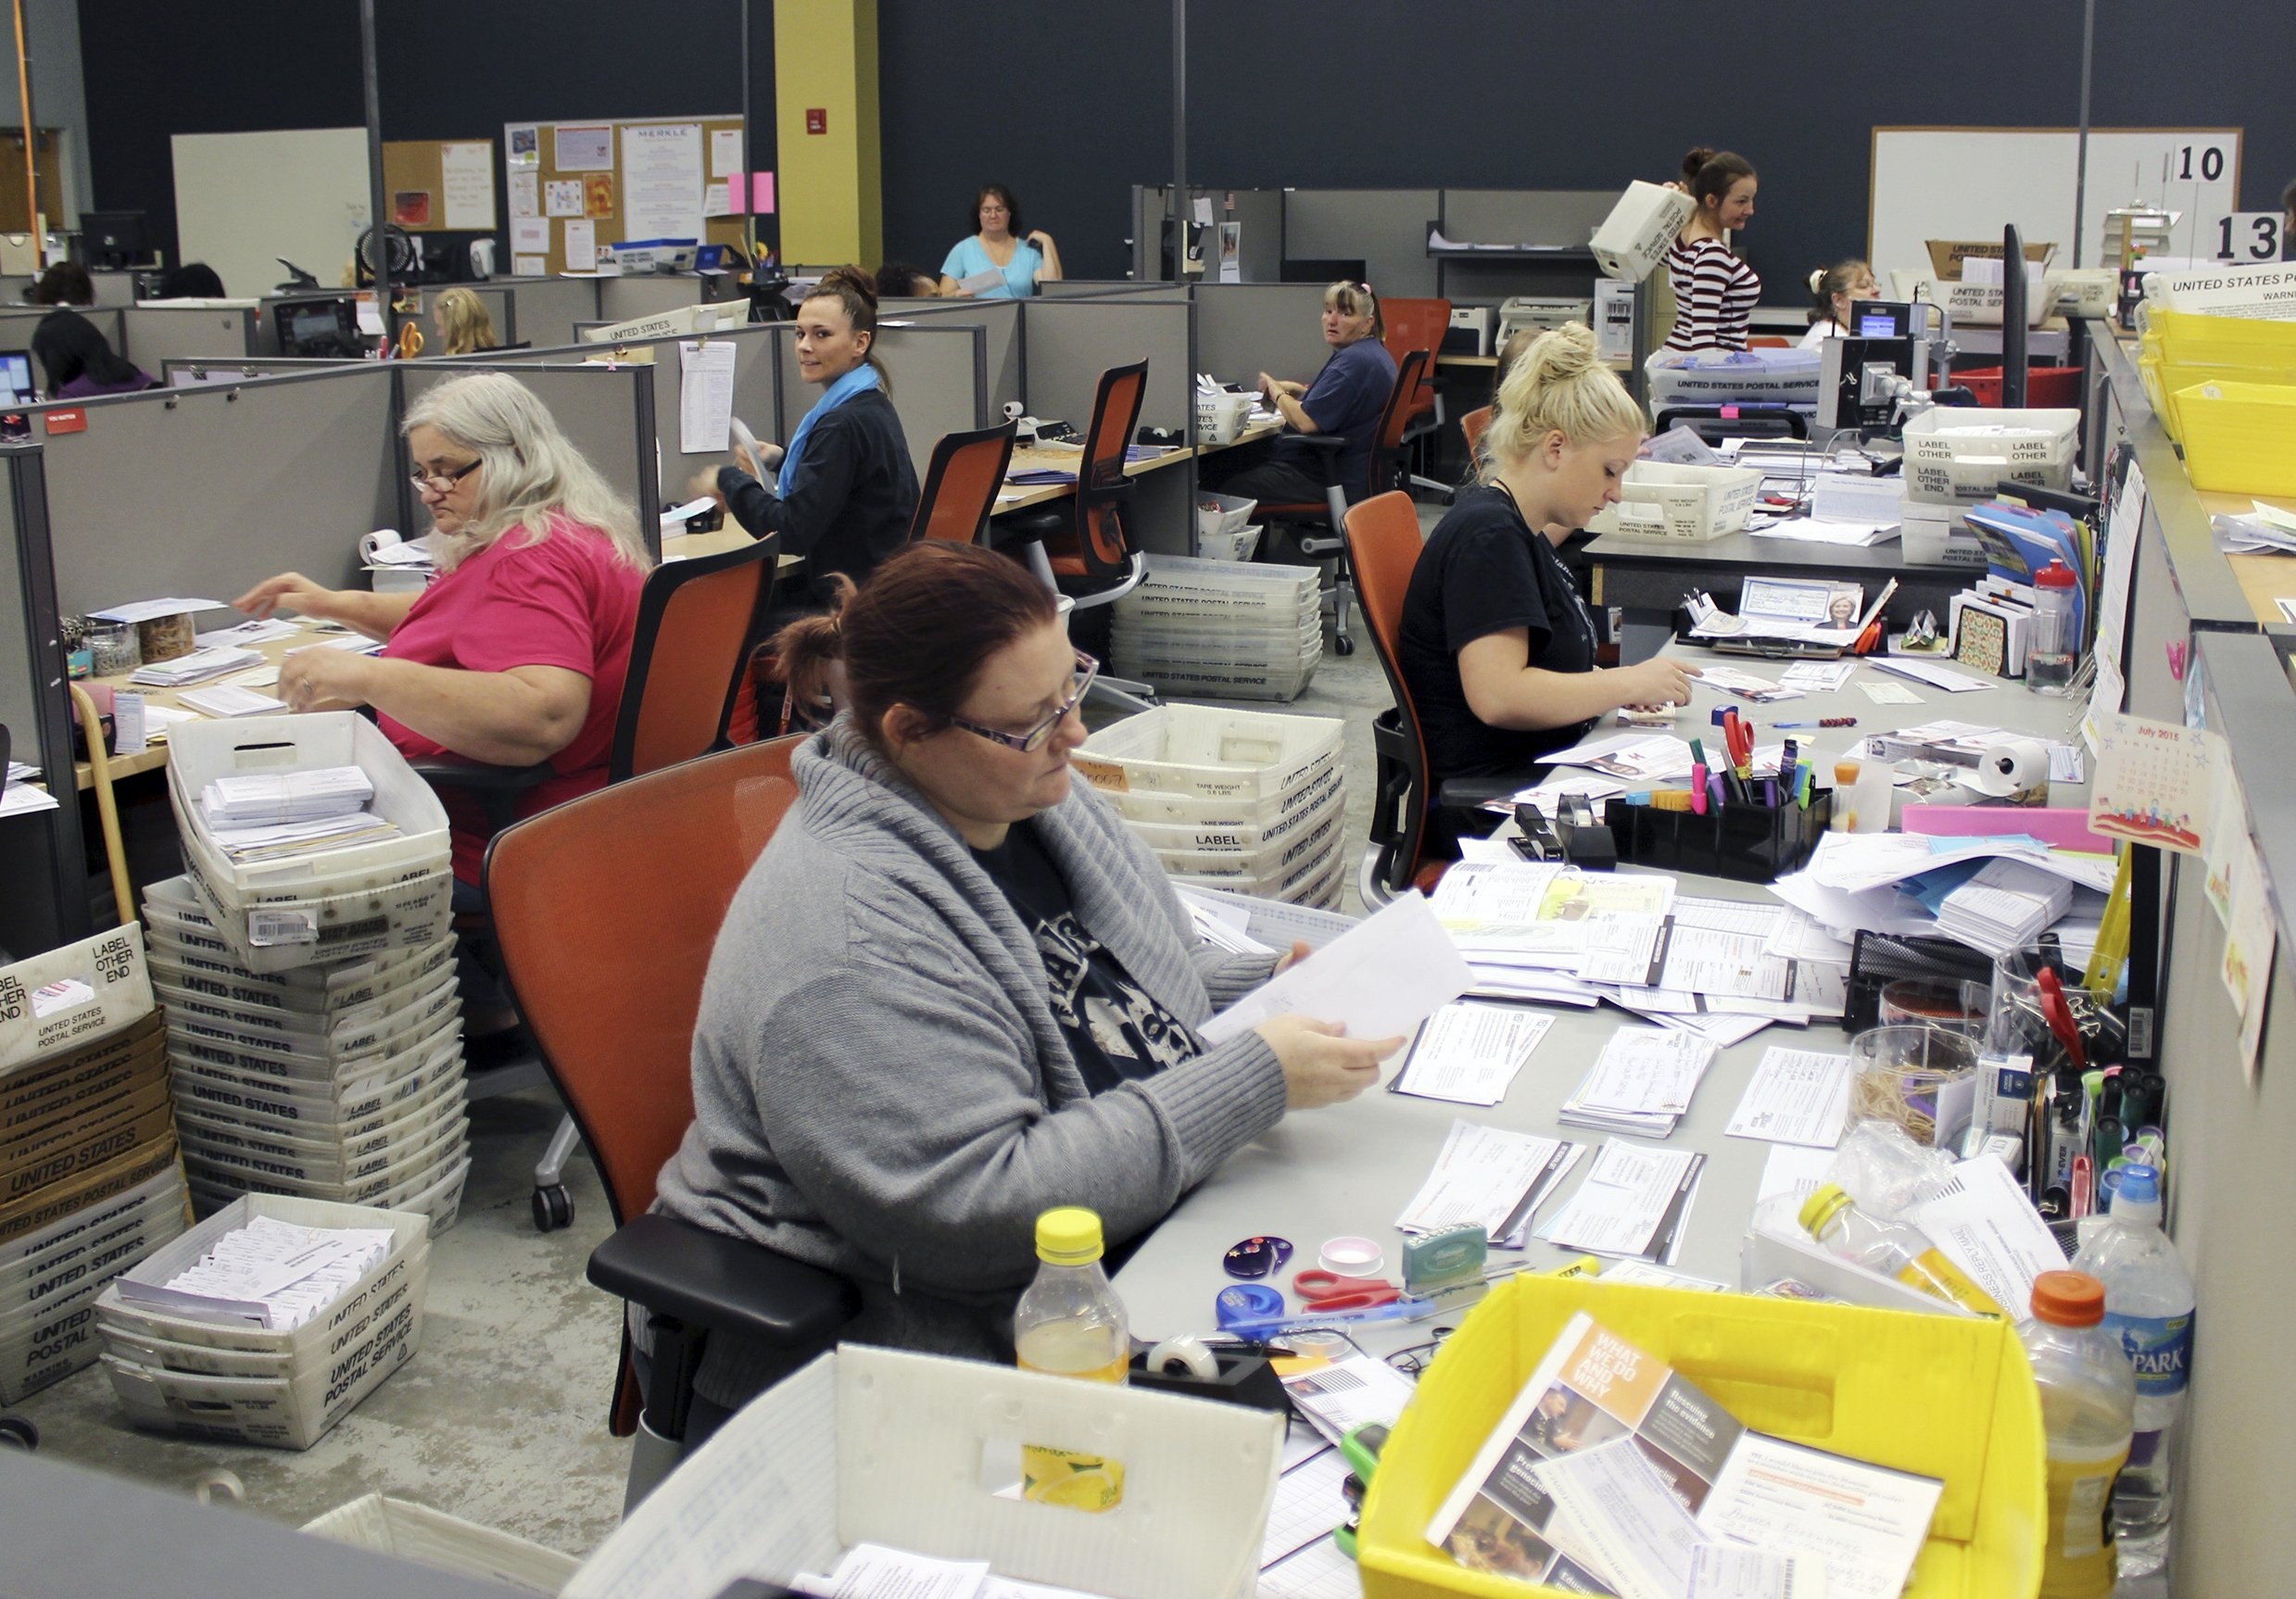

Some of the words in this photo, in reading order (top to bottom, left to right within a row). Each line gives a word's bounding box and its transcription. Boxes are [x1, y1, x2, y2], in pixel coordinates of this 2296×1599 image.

[638, 129, 688, 137] MERKLE
[2179, 145, 2224, 181] 10
[2216, 216, 2277, 259] 13
[1953, 288, 1985, 296] UNITED
[1988, 288, 2004, 296] STA
[2173, 279, 2223, 292] UNITED
[2227, 274, 2280, 288] STATES
[1949, 297, 1983, 306] POSTAL
[2263, 291, 2296, 300] WARNI
[610, 327, 638, 341] UNITED
[640, 321, 670, 334] STATES
[1678, 381, 1709, 389] UNITED
[1711, 381, 1744, 390] STATES
[1746, 381, 1780, 389] POSTAL
[1783, 380, 1820, 389] SERVICE
[1918, 450, 1951, 459] OTHER
[1919, 441, 1950, 449] LABEL
[2012, 442, 2046, 450] LABEL
[1917, 475, 1950, 485] OTHER
[1918, 468, 1949, 477] LABEL
[2011, 472, 2045, 480] LABEL
[1924, 484, 1944, 493] END
[2138, 726, 2155, 737] July
[2158, 730, 2179, 741] 2015
[1281, 785, 1309, 813] UNITED
[1262, 822, 1287, 842] UNITED
[1288, 808, 1308, 828] STATES
[1309, 794, 1328, 813] POSTAL
[1196, 836, 1240, 845] LABEL
[1282, 837, 1308, 866] UNITED
[1309, 819, 1332, 847] STATES
[93, 937, 131, 958] LABEL
[179, 932, 227, 952] UNITED
[96, 950, 133, 972] OTHER
[181, 956, 230, 974] UNITED
[0, 976, 22, 991] BEL
[107, 965, 130, 984] END
[0, 989, 26, 1008] HER
[183, 976, 228, 998] UNITED
[233, 988, 281, 1008] STATES
[340, 988, 373, 1004] LABEL
[0, 1006, 20, 1023] ND
[184, 1001, 230, 1019] UNITED
[39, 1018, 69, 1036] UNITED
[72, 1007, 102, 1026] STATES
[38, 1031, 69, 1048] POSTAL
[72, 1017, 106, 1036] SERVICE
[344, 1034, 377, 1051] LABEL
[188, 1043, 235, 1064] UNITED
[239, 1055, 288, 1076] STATES
[192, 1085, 242, 1107] UNITED
[246, 1098, 298, 1120] STATES
[350, 1099, 382, 1114] LABEL
[352, 1119, 385, 1137] LABEL
[357, 1136, 388, 1153] LABEL
[10, 1152, 74, 1191] UNITED
[78, 1127, 135, 1165] STATES
[358, 1157, 389, 1173] LABEL
[252, 1160, 305, 1180] STATES
[359, 1177, 390, 1195] LABEL
[0, 1216, 31, 1237] ITED
[35, 1195, 81, 1225] STATES
[83, 1176, 126, 1202] POSTAL
[373, 1199, 390, 1209] BEL
[1954, 1228, 1970, 1247] MAIL
[30, 1265, 86, 1301] UNITED
[92, 1236, 145, 1272] STATES
[1966, 1249, 1989, 1276] REPLY
[328, 1293, 367, 1331] UNITED
[331, 1316, 371, 1354] UNITED
[372, 1283, 408, 1322] STATES
[33, 1307, 92, 1344] UNITED
[27, 1328, 89, 1367] POSTAL
[331, 1340, 373, 1383] UNITED
[374, 1303, 411, 1348] STATES
[1599, 1332, 1642, 1366] WHAT
[323, 1362, 368, 1408] POSTAL
[371, 1317, 414, 1367] SERVICE
[1591, 1345, 1615, 1367] WE
[1613, 1360, 1636, 1382] DO
[2133, 1348, 2183, 1373] PARK
[1579, 1359, 1614, 1383] AND
[1573, 1370, 1611, 1399] WHY
[1670, 1390, 1709, 1422] Rescuing
[1666, 1400, 1681, 1415] the
[1679, 1408, 1715, 1440] evidence
